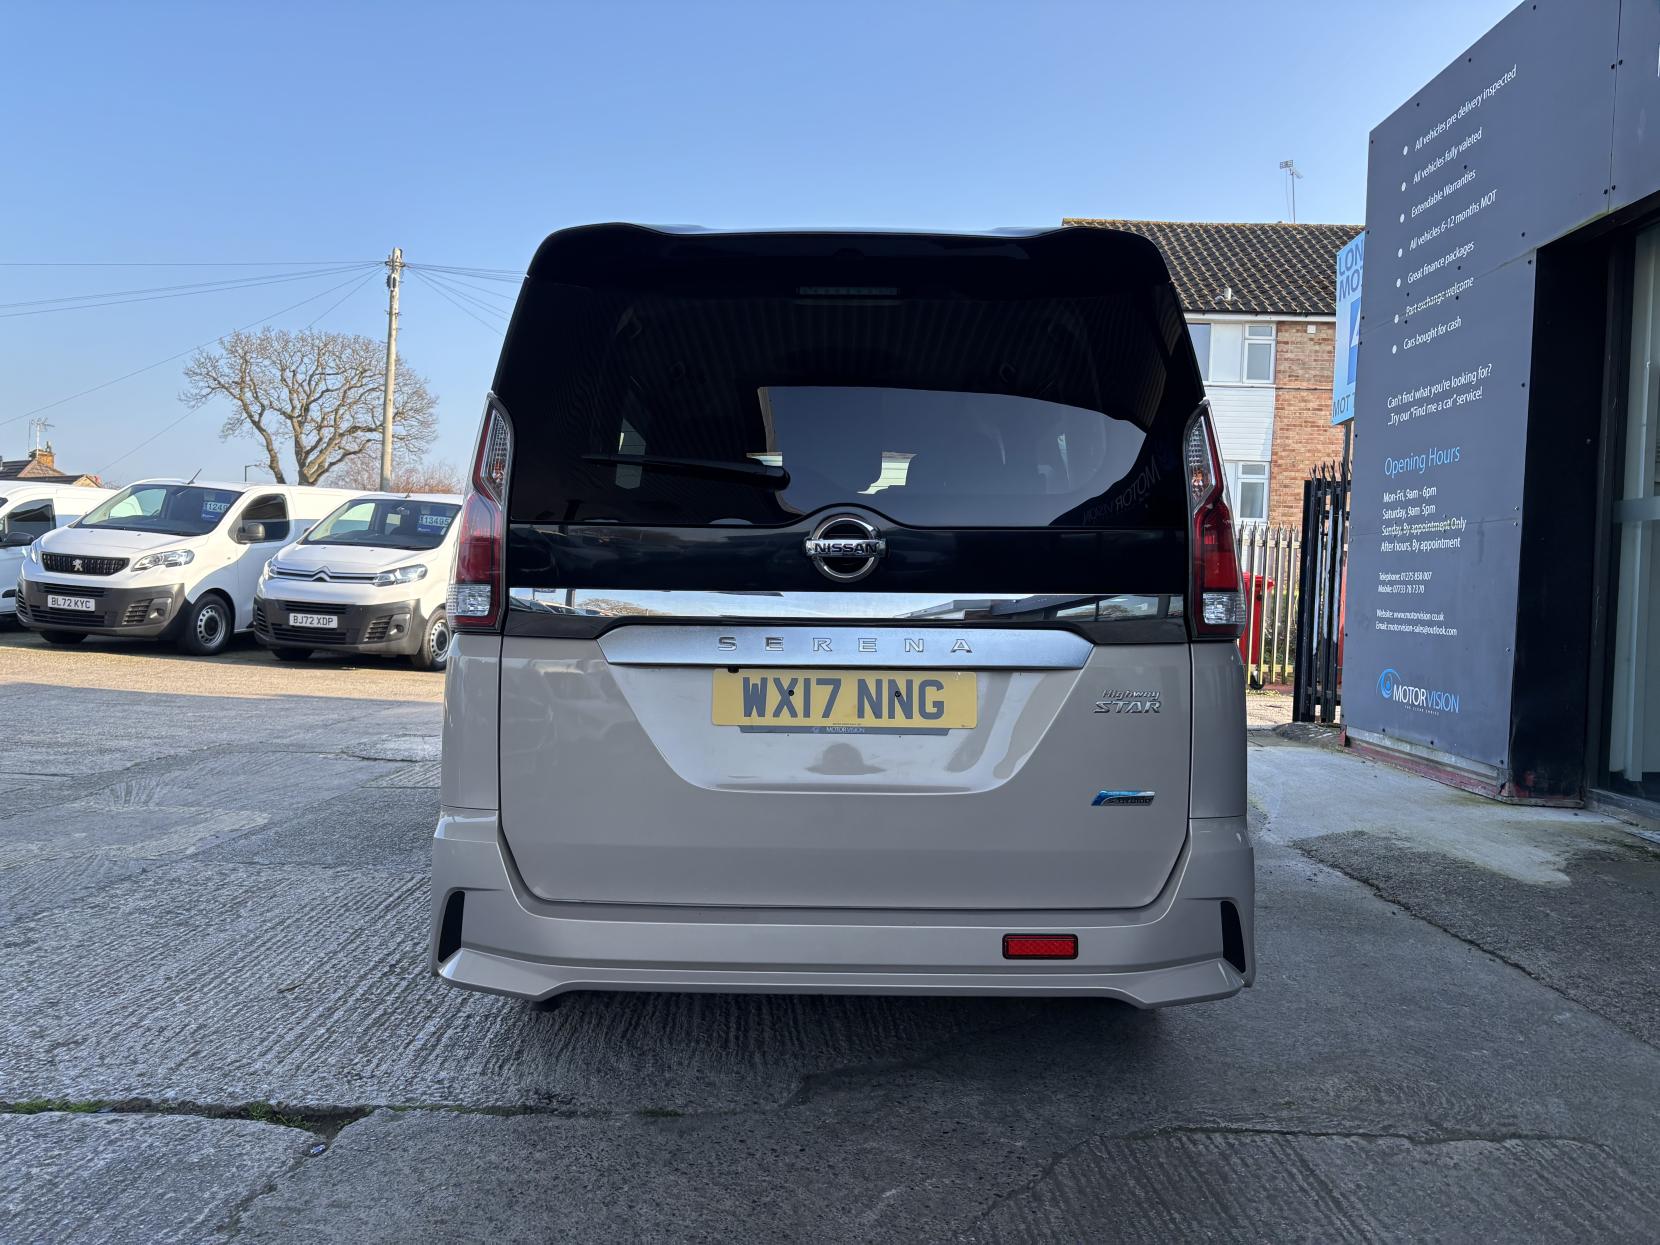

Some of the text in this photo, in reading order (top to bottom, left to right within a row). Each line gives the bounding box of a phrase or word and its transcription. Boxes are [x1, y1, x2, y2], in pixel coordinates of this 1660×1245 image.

[1415, 64, 1517, 151] All vehicles pre delivery inspected
[1413, 127, 1482, 184] All vehicles fully valeted
[1411, 169, 1476, 218] Extendable Warranties
[1409, 189, 1497, 251] All vehicles 6-12 months MOT
[1407, 241, 1475, 284] Great finance packages
[1338, 268, 1363, 302] MO
[1405, 277, 1474, 317] Part exchange welcome
[1403, 316, 1462, 350] Cars bought for cash
[1387, 363, 1493, 409] Can't find what you're looking for?
[1400, 410, 1411, 422] our
[1426, 405, 1437, 415] me
[1437, 401, 1443, 411] a
[1456, 386, 1483, 406] service!
[1384, 446, 1461, 479] Opening Hours
[1405, 488, 1418, 500] 9am
[1422, 486, 1437, 499] 6pm
[1382, 503, 1436, 520] Saturday, 9am 5pm
[1381, 516, 1467, 537] Sunday, By appointment Only
[814, 543, 878, 554] NISSAN
[1381, 537, 1461, 553] After hours, By appointment
[1379, 571, 1400, 582] Telephone:
[51, 596, 91, 609] BL72 KYC
[1376, 608, 1393, 618] Website:
[293, 615, 334, 626] BJ72 XDP
[1388, 622, 1458, 636] motorvision-sales@outlook.com
[718, 636, 973, 653] SERENA
[742, 676, 945, 721] WX17 NNG
[1102, 688, 1160, 701] Highway
[1093, 700, 1161, 714] STAR
